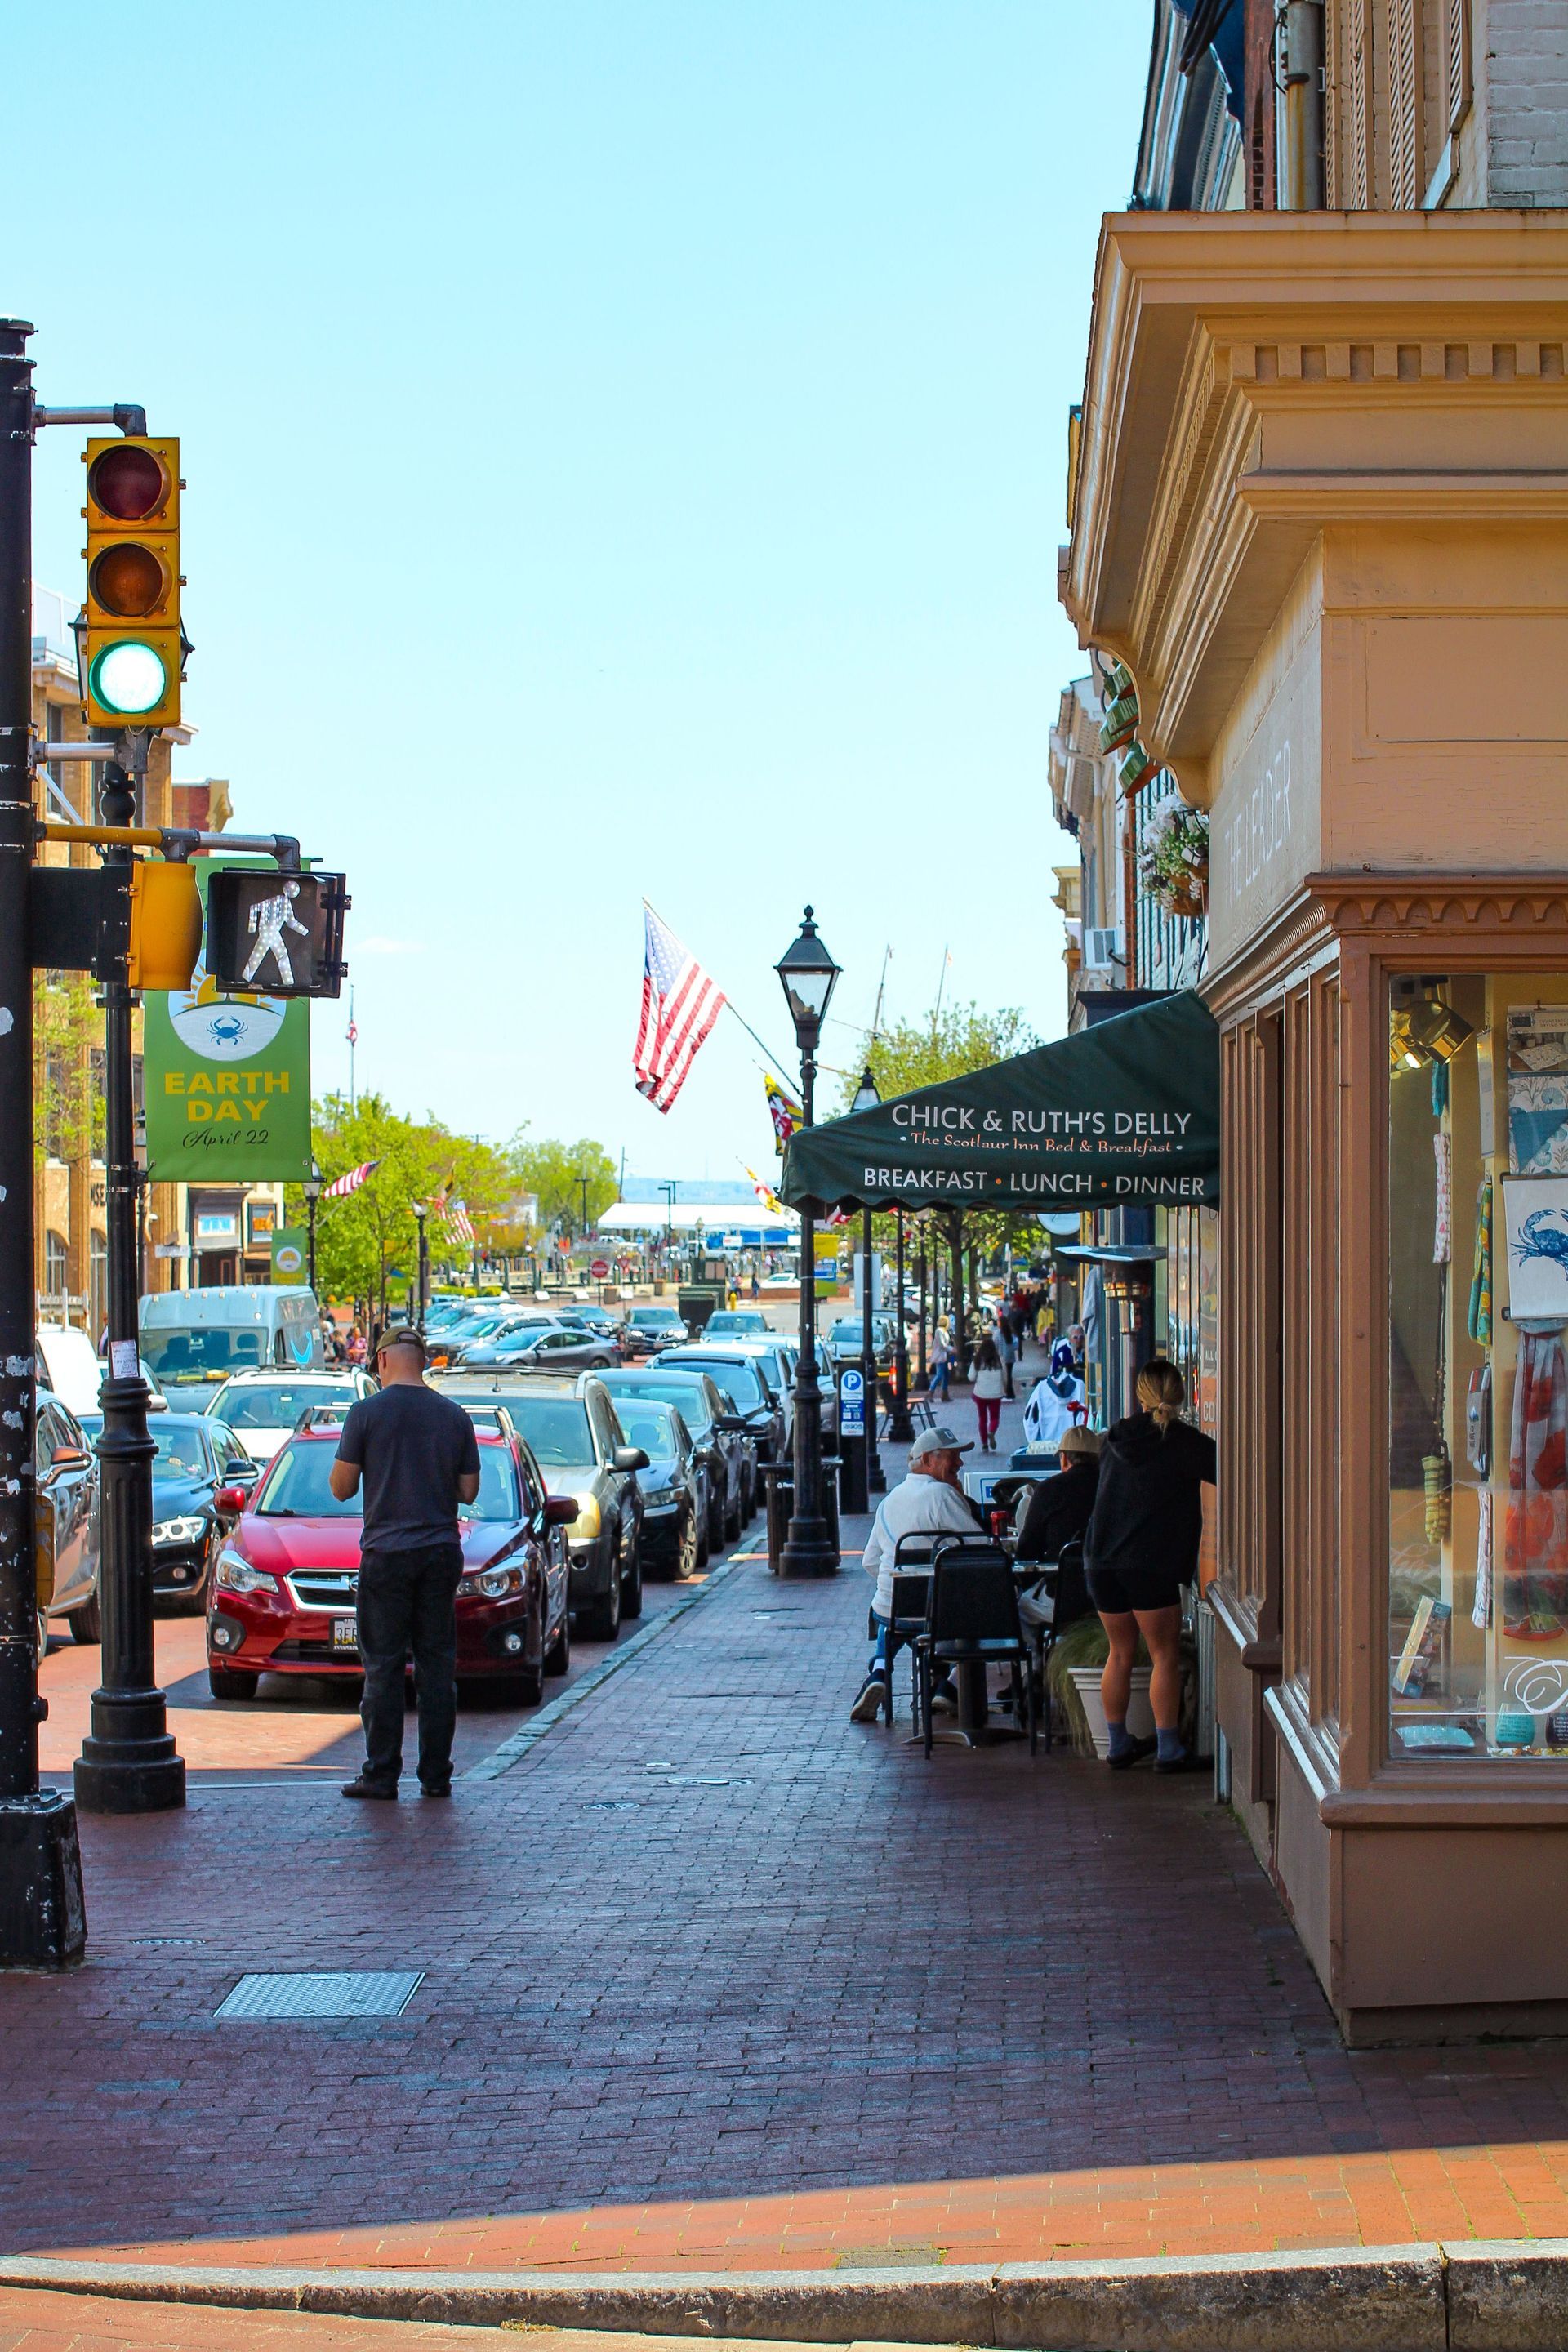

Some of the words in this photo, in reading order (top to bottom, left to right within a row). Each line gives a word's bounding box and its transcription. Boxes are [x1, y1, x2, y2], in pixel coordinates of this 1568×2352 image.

[1225, 810, 1242, 910] THE
[1245, 739, 1291, 889] LEADER
[165, 1071, 290, 1095] EARTH
[187, 1099, 269, 1122] DAY
[892, 1104, 975, 1130] CHICK
[982, 1110, 1002, 1132] &
[1012, 1111, 1106, 1134] RUTH'S
[1114, 1112, 1192, 1135] DELLY
[182, 1127, 242, 1151] April
[246, 1129, 269, 1145] 22
[910, 1130, 939, 1145] The
[943, 1134, 1009, 1150] Scotlaur
[1013, 1138, 1040, 1152] Inn
[1045, 1137, 1074, 1152] Bed
[1079, 1139, 1094, 1152] &
[1098, 1138, 1173, 1158] Breakfast
[864, 1167, 988, 1190] BREAKFAST
[1010, 1172, 1093, 1193] LUNCH
[1116, 1176, 1205, 1196] DINNER
[847, 1374, 858, 1388] P
